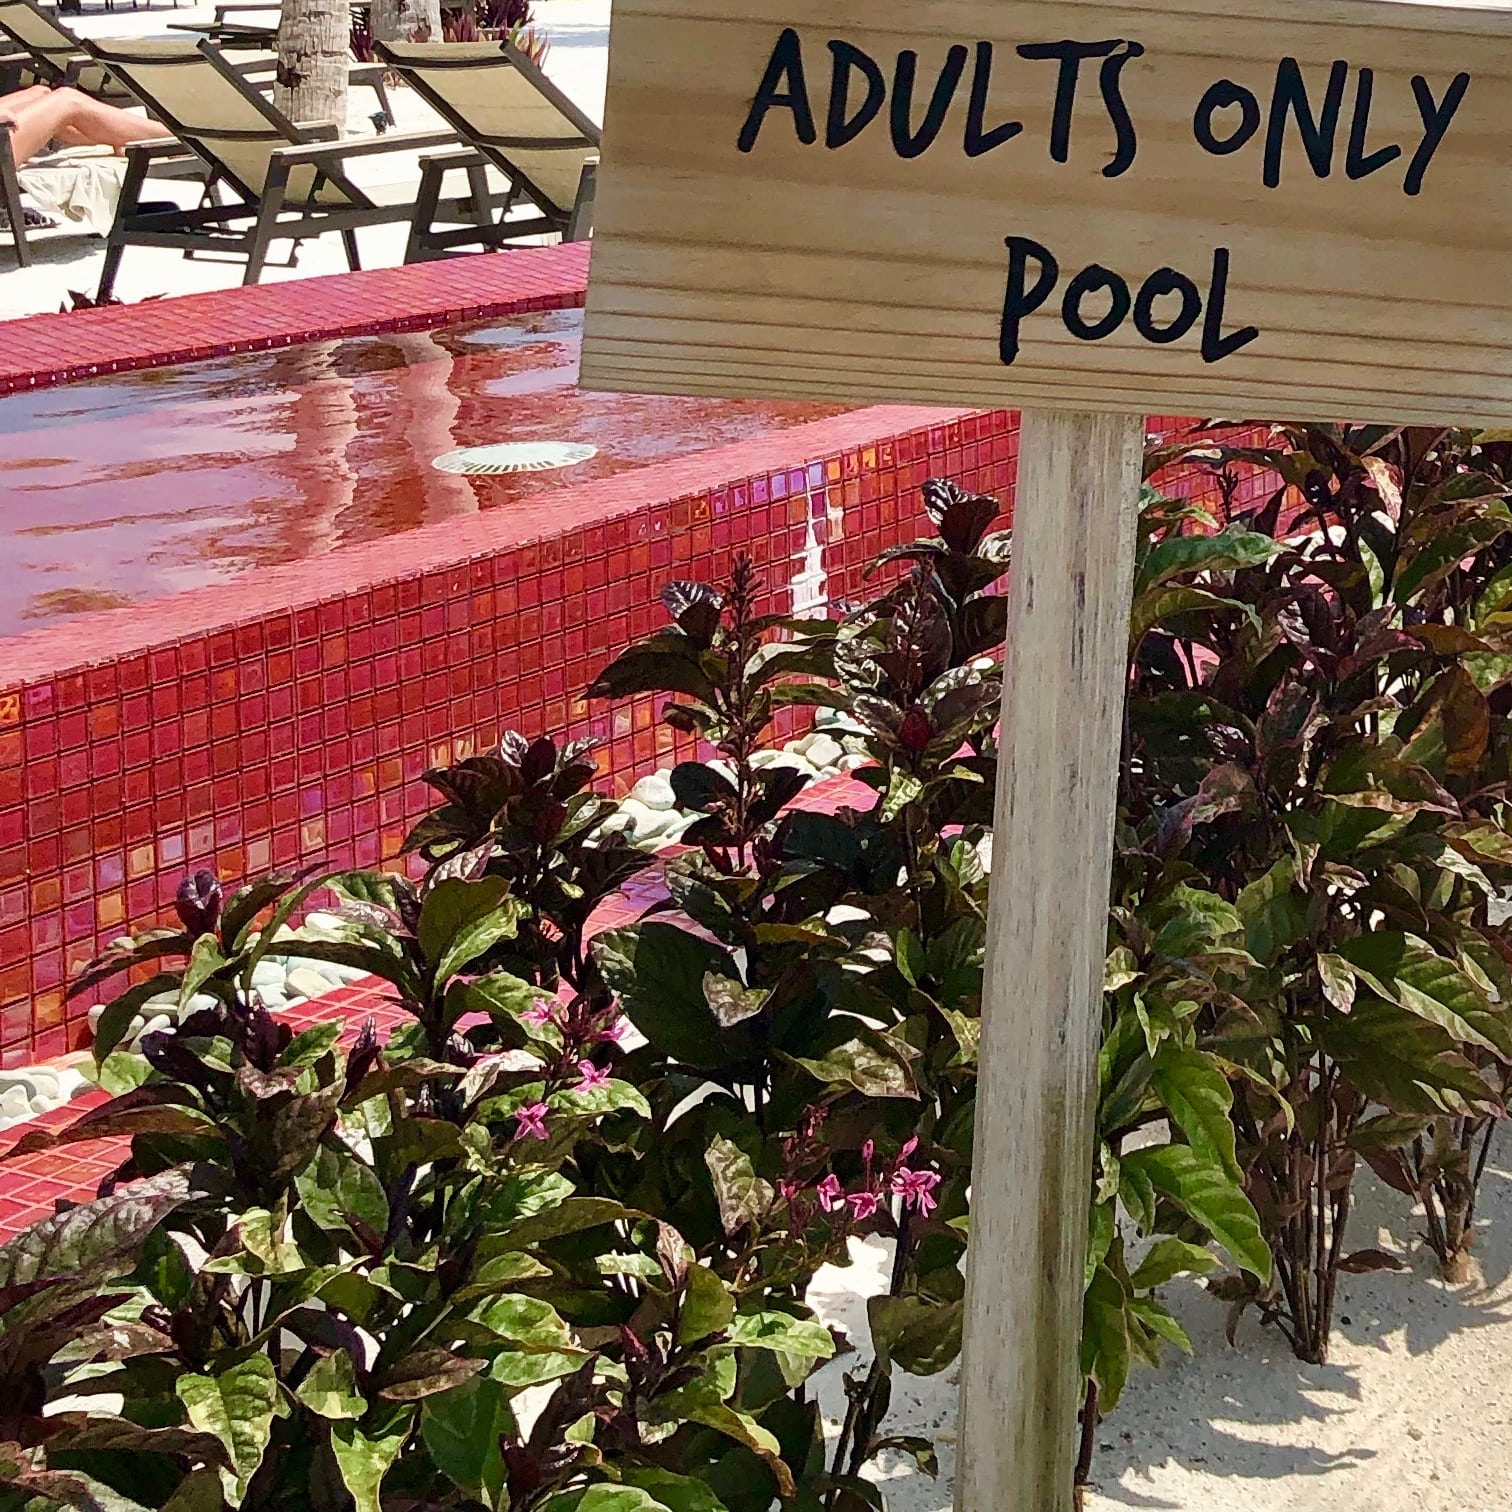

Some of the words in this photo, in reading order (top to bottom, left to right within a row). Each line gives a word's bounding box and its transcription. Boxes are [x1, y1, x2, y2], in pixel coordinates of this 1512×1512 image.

[735, 26, 1147, 179] ADULTS
[1193, 55, 1471, 197] ONLY
[997, 234, 1260, 367] POOL
